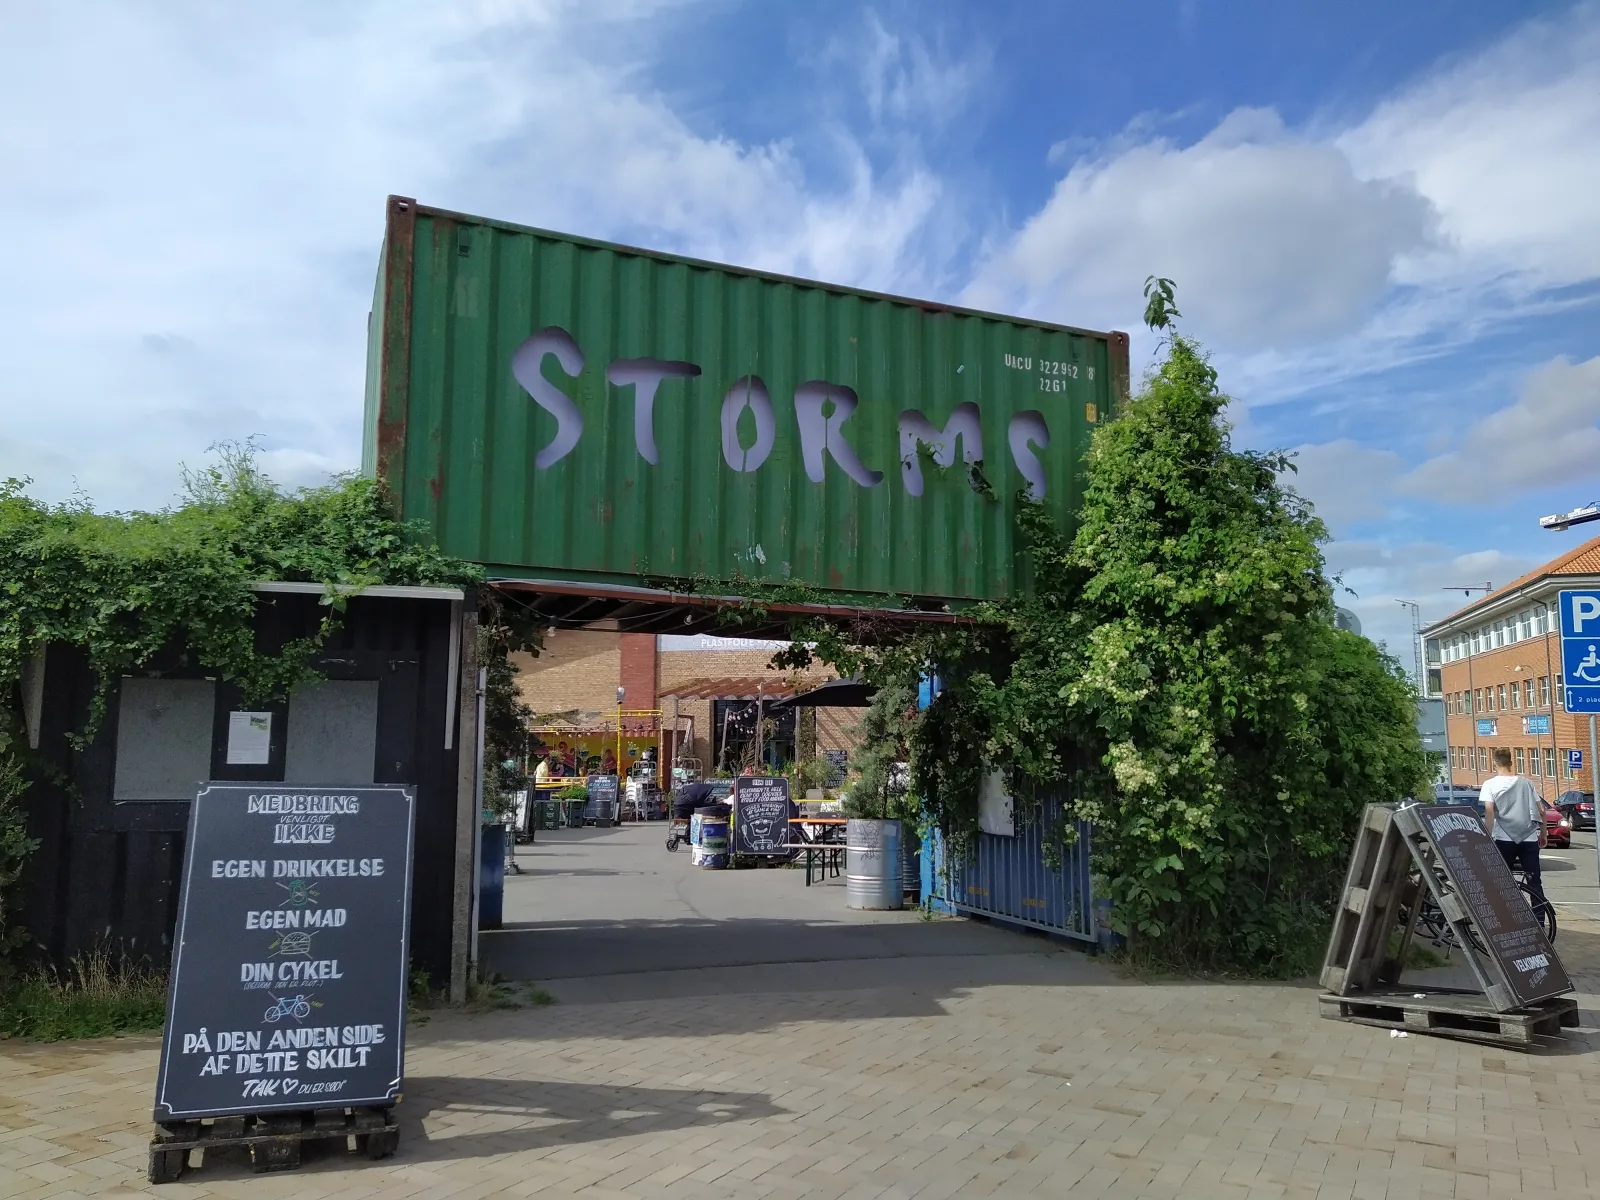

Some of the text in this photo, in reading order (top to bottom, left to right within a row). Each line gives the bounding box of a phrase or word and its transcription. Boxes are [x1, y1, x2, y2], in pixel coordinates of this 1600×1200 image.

[1005, 353, 1032, 370] UACU
[1039, 377, 1067, 392] 22G1
[511, 325, 1050, 502] STORMS
[1571, 595, 1600, 633] P
[1571, 751, 1580, 761] P
[247, 794, 360, 814] MEDBRING
[280, 815, 330, 823] VENLIGST
[1426, 812, 1487, 842] ÅBNINGSTIDER
[273, 824, 335, 844] IKKE
[211, 858, 386, 878] EGEN DRIKKELSE
[245, 908, 347, 930] EGEN MAD
[240, 959, 344, 982] DIN CYKEL
[1513, 953, 1550, 973] VELKOMMEN
[182, 1024, 386, 1054] PÅ DEN ANDEN SIDE
[199, 1047, 372, 1077] AF DETTE SKILT
[242, 1079, 281, 1098] TAK
[298, 1084, 313, 1095] DU
[312, 1082, 325, 1094] ER
